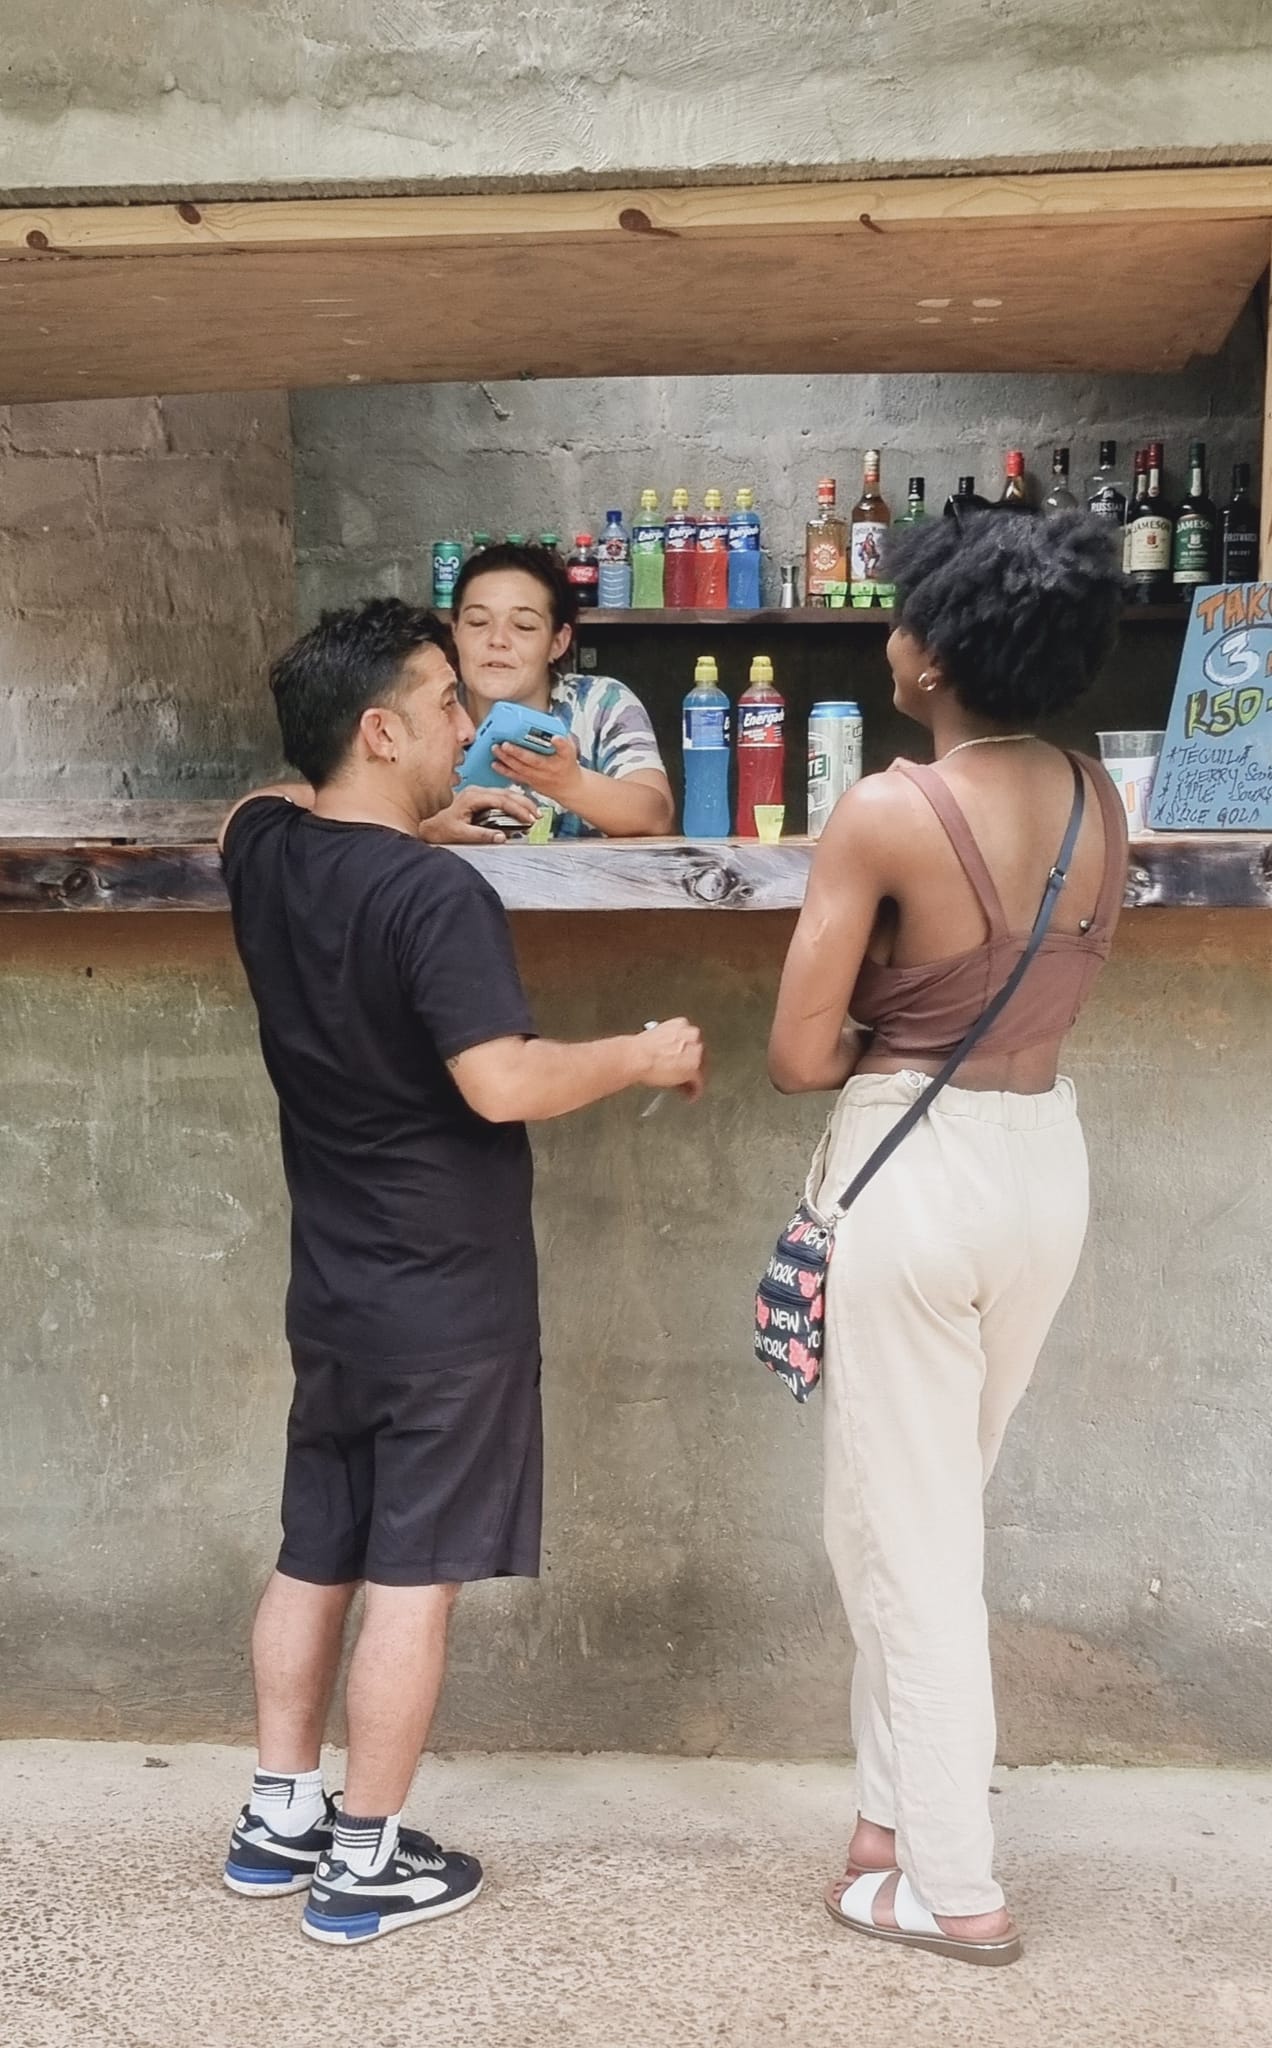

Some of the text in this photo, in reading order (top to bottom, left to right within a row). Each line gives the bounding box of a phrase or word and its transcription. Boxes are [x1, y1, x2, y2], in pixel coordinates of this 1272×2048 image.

[1176, 519, 1210, 533] JAMESO
[1196, 583, 1272, 635] TAK
[771, 1307, 799, 1334] NEW
